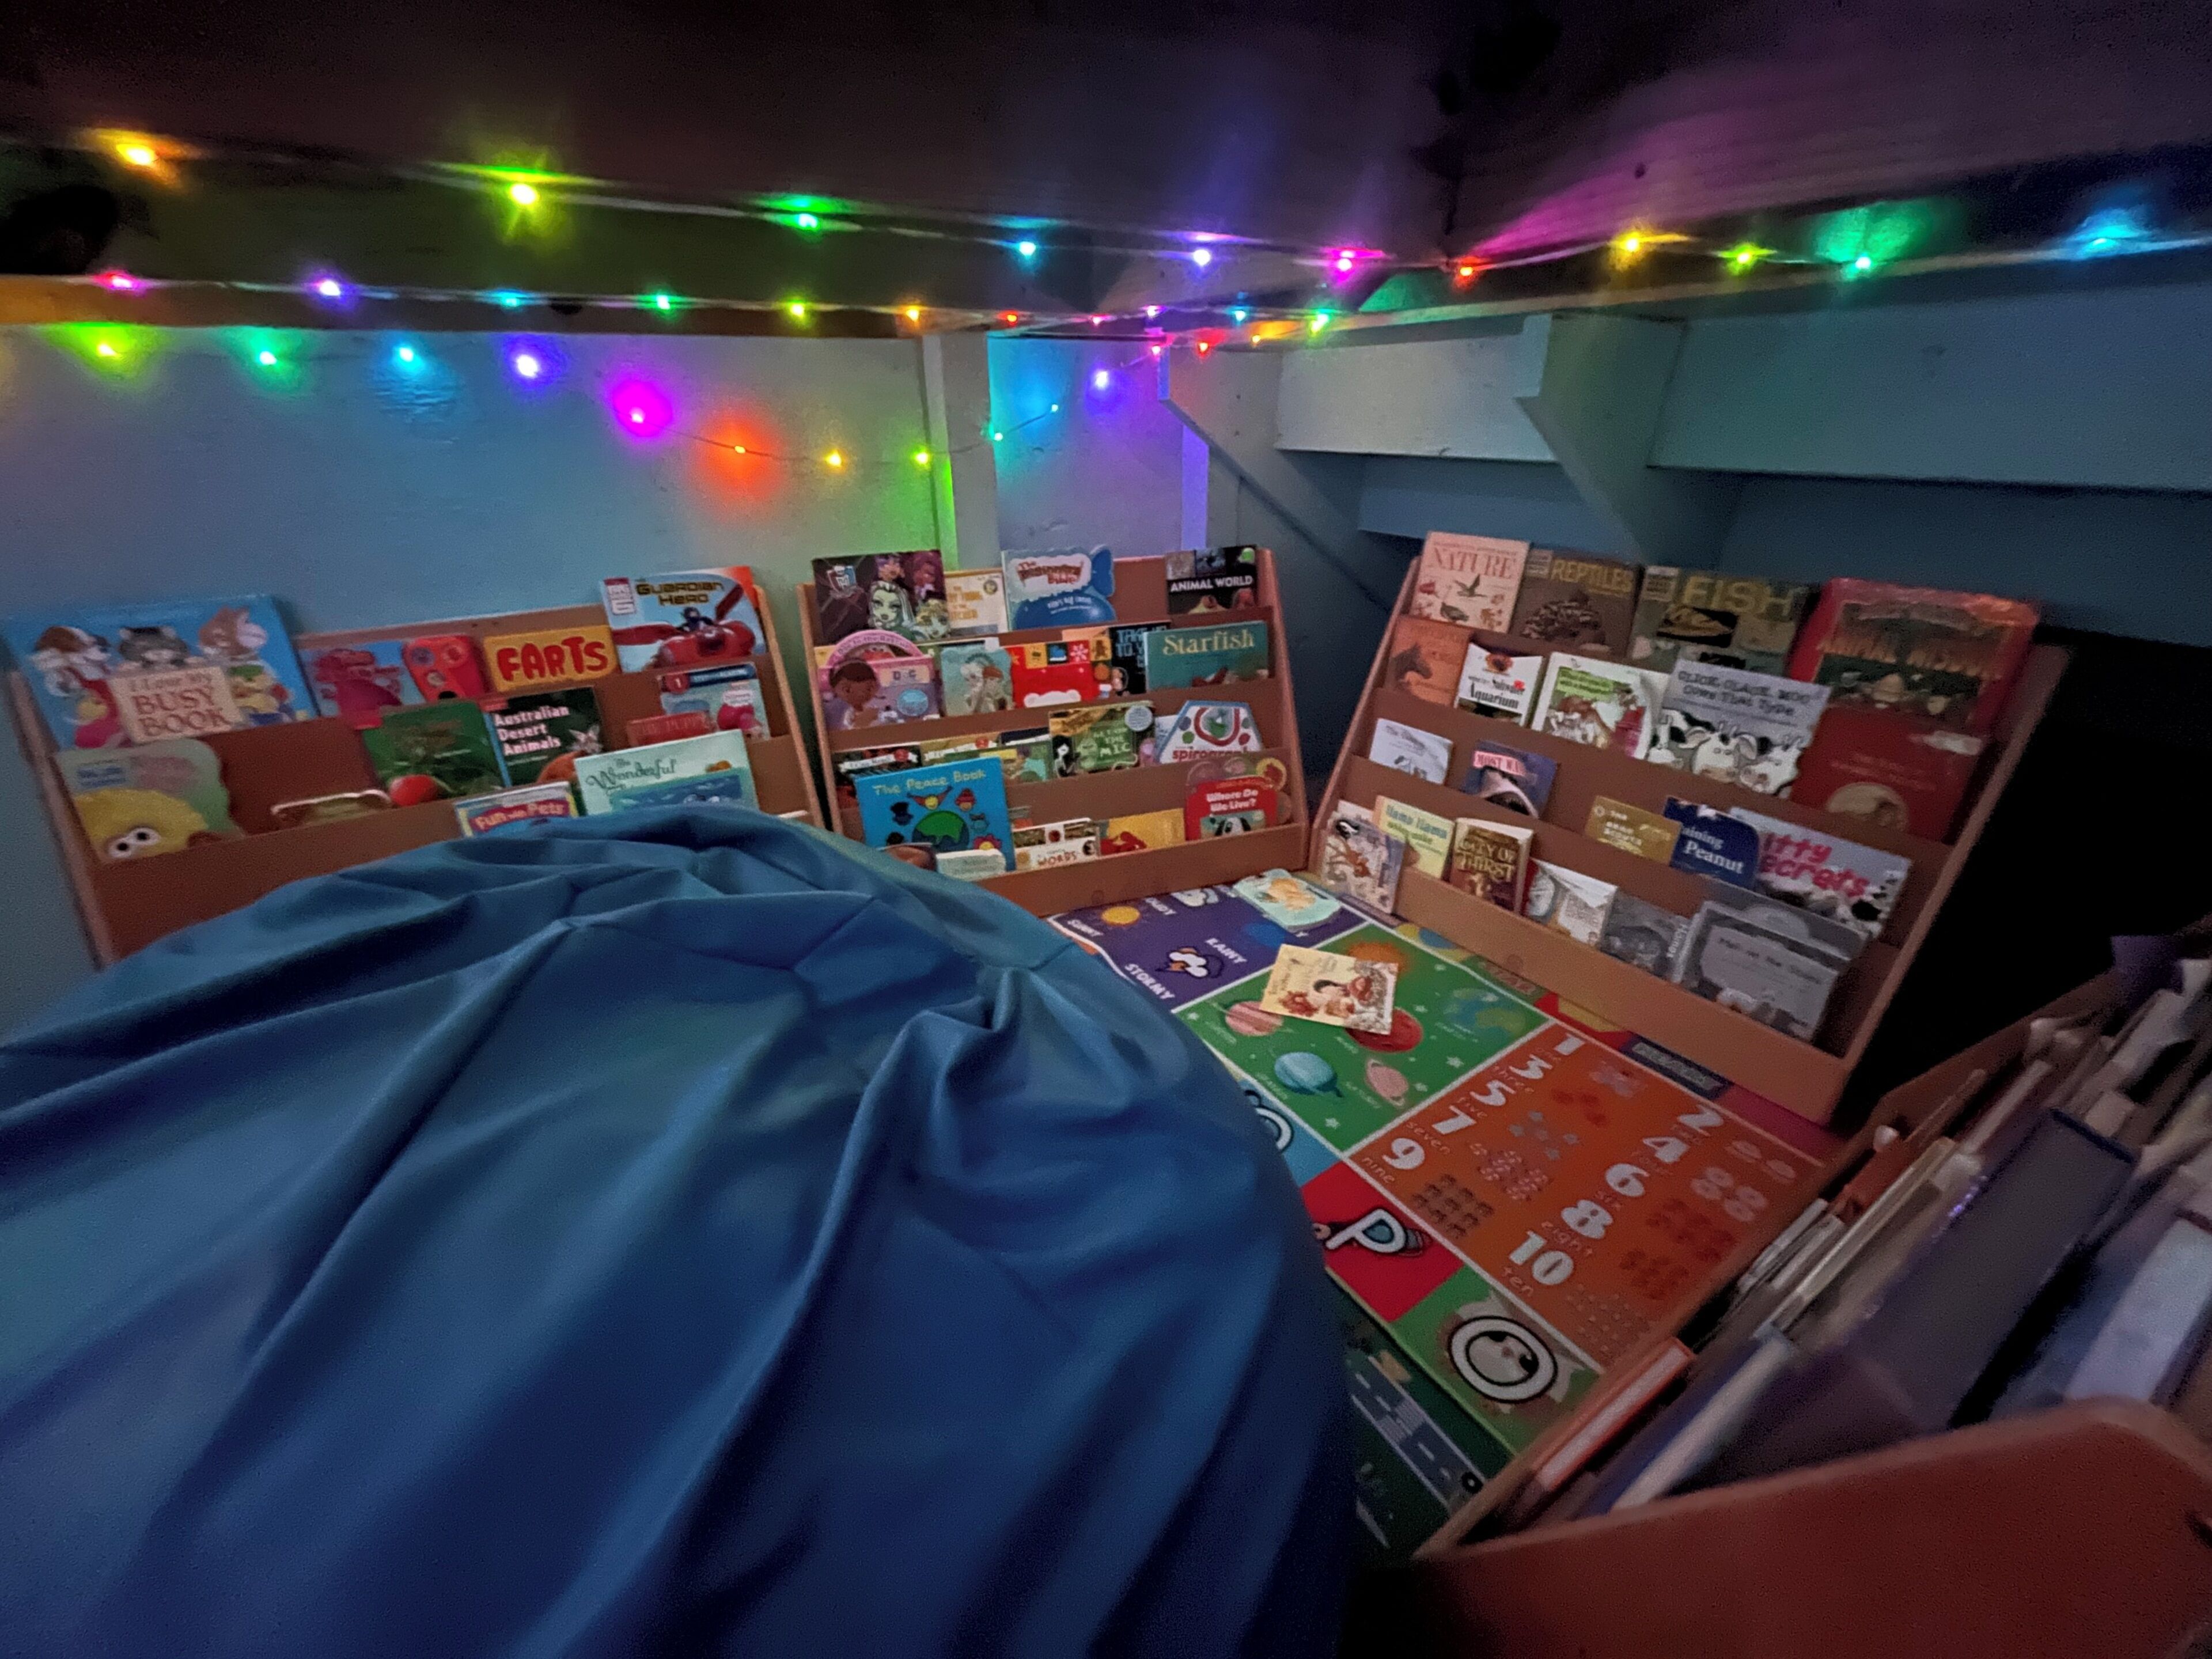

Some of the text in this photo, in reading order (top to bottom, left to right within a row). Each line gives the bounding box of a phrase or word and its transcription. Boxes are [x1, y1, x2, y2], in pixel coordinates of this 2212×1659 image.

[1428, 547, 1517, 579] NATURE
[1170, 575, 1253, 593] ANIMAL WORLD
[1683, 575, 1808, 617] FISH
[1162, 628, 1255, 656] Starfish
[496, 635, 609, 682] FARTS
[675, 677, 682, 688] 1
[1470, 681, 1520, 709] Aquarium
[132, 687, 214, 715] BUSY
[137, 707, 234, 737] BOOK
[494, 705, 570, 726] Australian
[497, 723, 547, 742] Desert
[503, 735, 562, 756] Animals
[585, 757, 677, 791] Wonderful
[873, 769, 987, 796] The Peace Book
[1206, 788, 1259, 802] Where Do
[1229, 797, 1257, 810] Live?
[475, 812, 507, 830] Fun
[528, 802, 565, 816] Pets
[1037, 850, 1078, 866] WORDS
[1683, 840, 1745, 874] Peanut
[1763, 832, 1833, 863] itty
[1455, 852, 1516, 882] THIRST
[1759, 854, 1871, 898] ecrets
[1205, 937, 1248, 964] RAINY
[1125, 963, 1175, 1000] STORMY
[1554, 1032, 1586, 1056] 1
[1509, 1054, 1554, 1080] 3
[1469, 1079, 1517, 1107] 5
[1431, 1104, 1478, 1135] 7
[1676, 1104, 1725, 1137] 2
[1405, 1122, 1451, 1155] seven
[1642, 1136, 1691, 1164] 4
[1381, 1137, 1426, 1171] 9
[1361, 1156, 1396, 1184] nine
[1605, 1162, 1650, 1198] 6
[1560, 1199, 1613, 1240] 8
[1508, 1229, 1575, 1286] 10
[1502, 1266, 1534, 1297] ten
